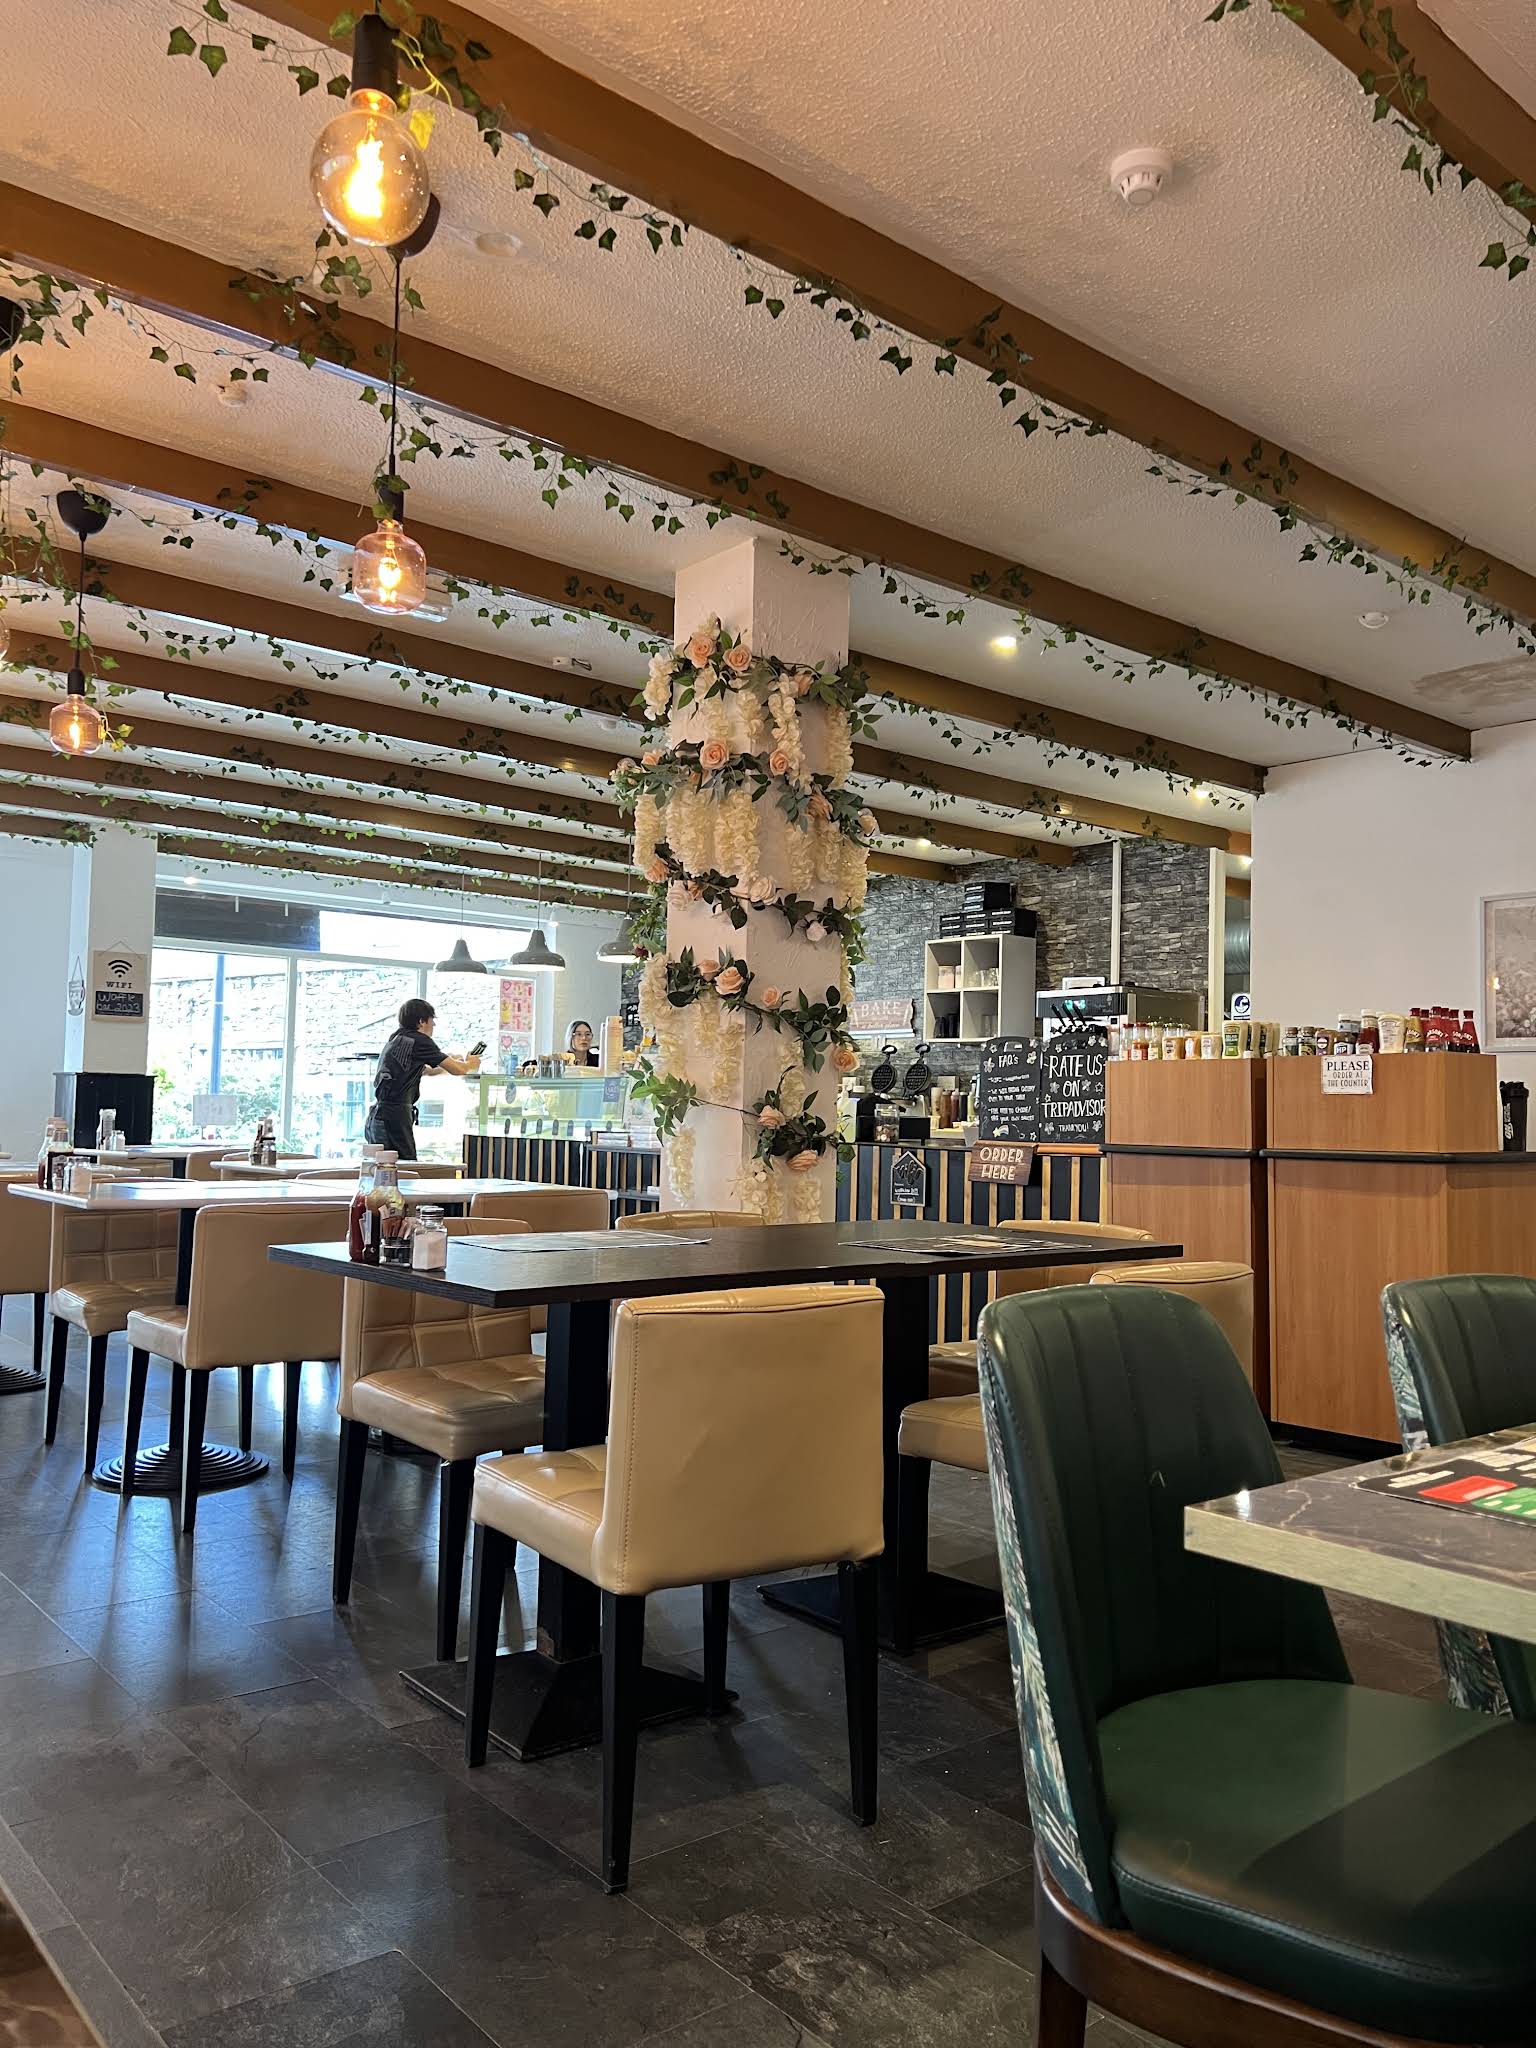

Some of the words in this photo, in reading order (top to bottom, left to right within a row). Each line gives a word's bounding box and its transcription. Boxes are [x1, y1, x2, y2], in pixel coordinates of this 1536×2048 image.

[861, 1001, 901, 1017] BAKE
[998, 1054, 1019, 1067] FAQ's
[1048, 1055, 1084, 1078] RATE
[1087, 1054, 1103, 1076] US
[1327, 1060, 1369, 1071] PLEASE
[1332, 1071, 1353, 1079] ORDER
[1356, 1071, 1363, 1079] AT
[1063, 1080, 1080, 1097] ON
[1340, 1079, 1369, 1087] COUNTER
[1041, 1099, 1106, 1118] TRIPADVISOR
[1058, 1123, 1075, 1132] THANK
[1074, 1122, 1089, 1132] YOU!
[980, 1147, 1023, 1162] ORDER
[981, 1165, 1016, 1180] HERE
